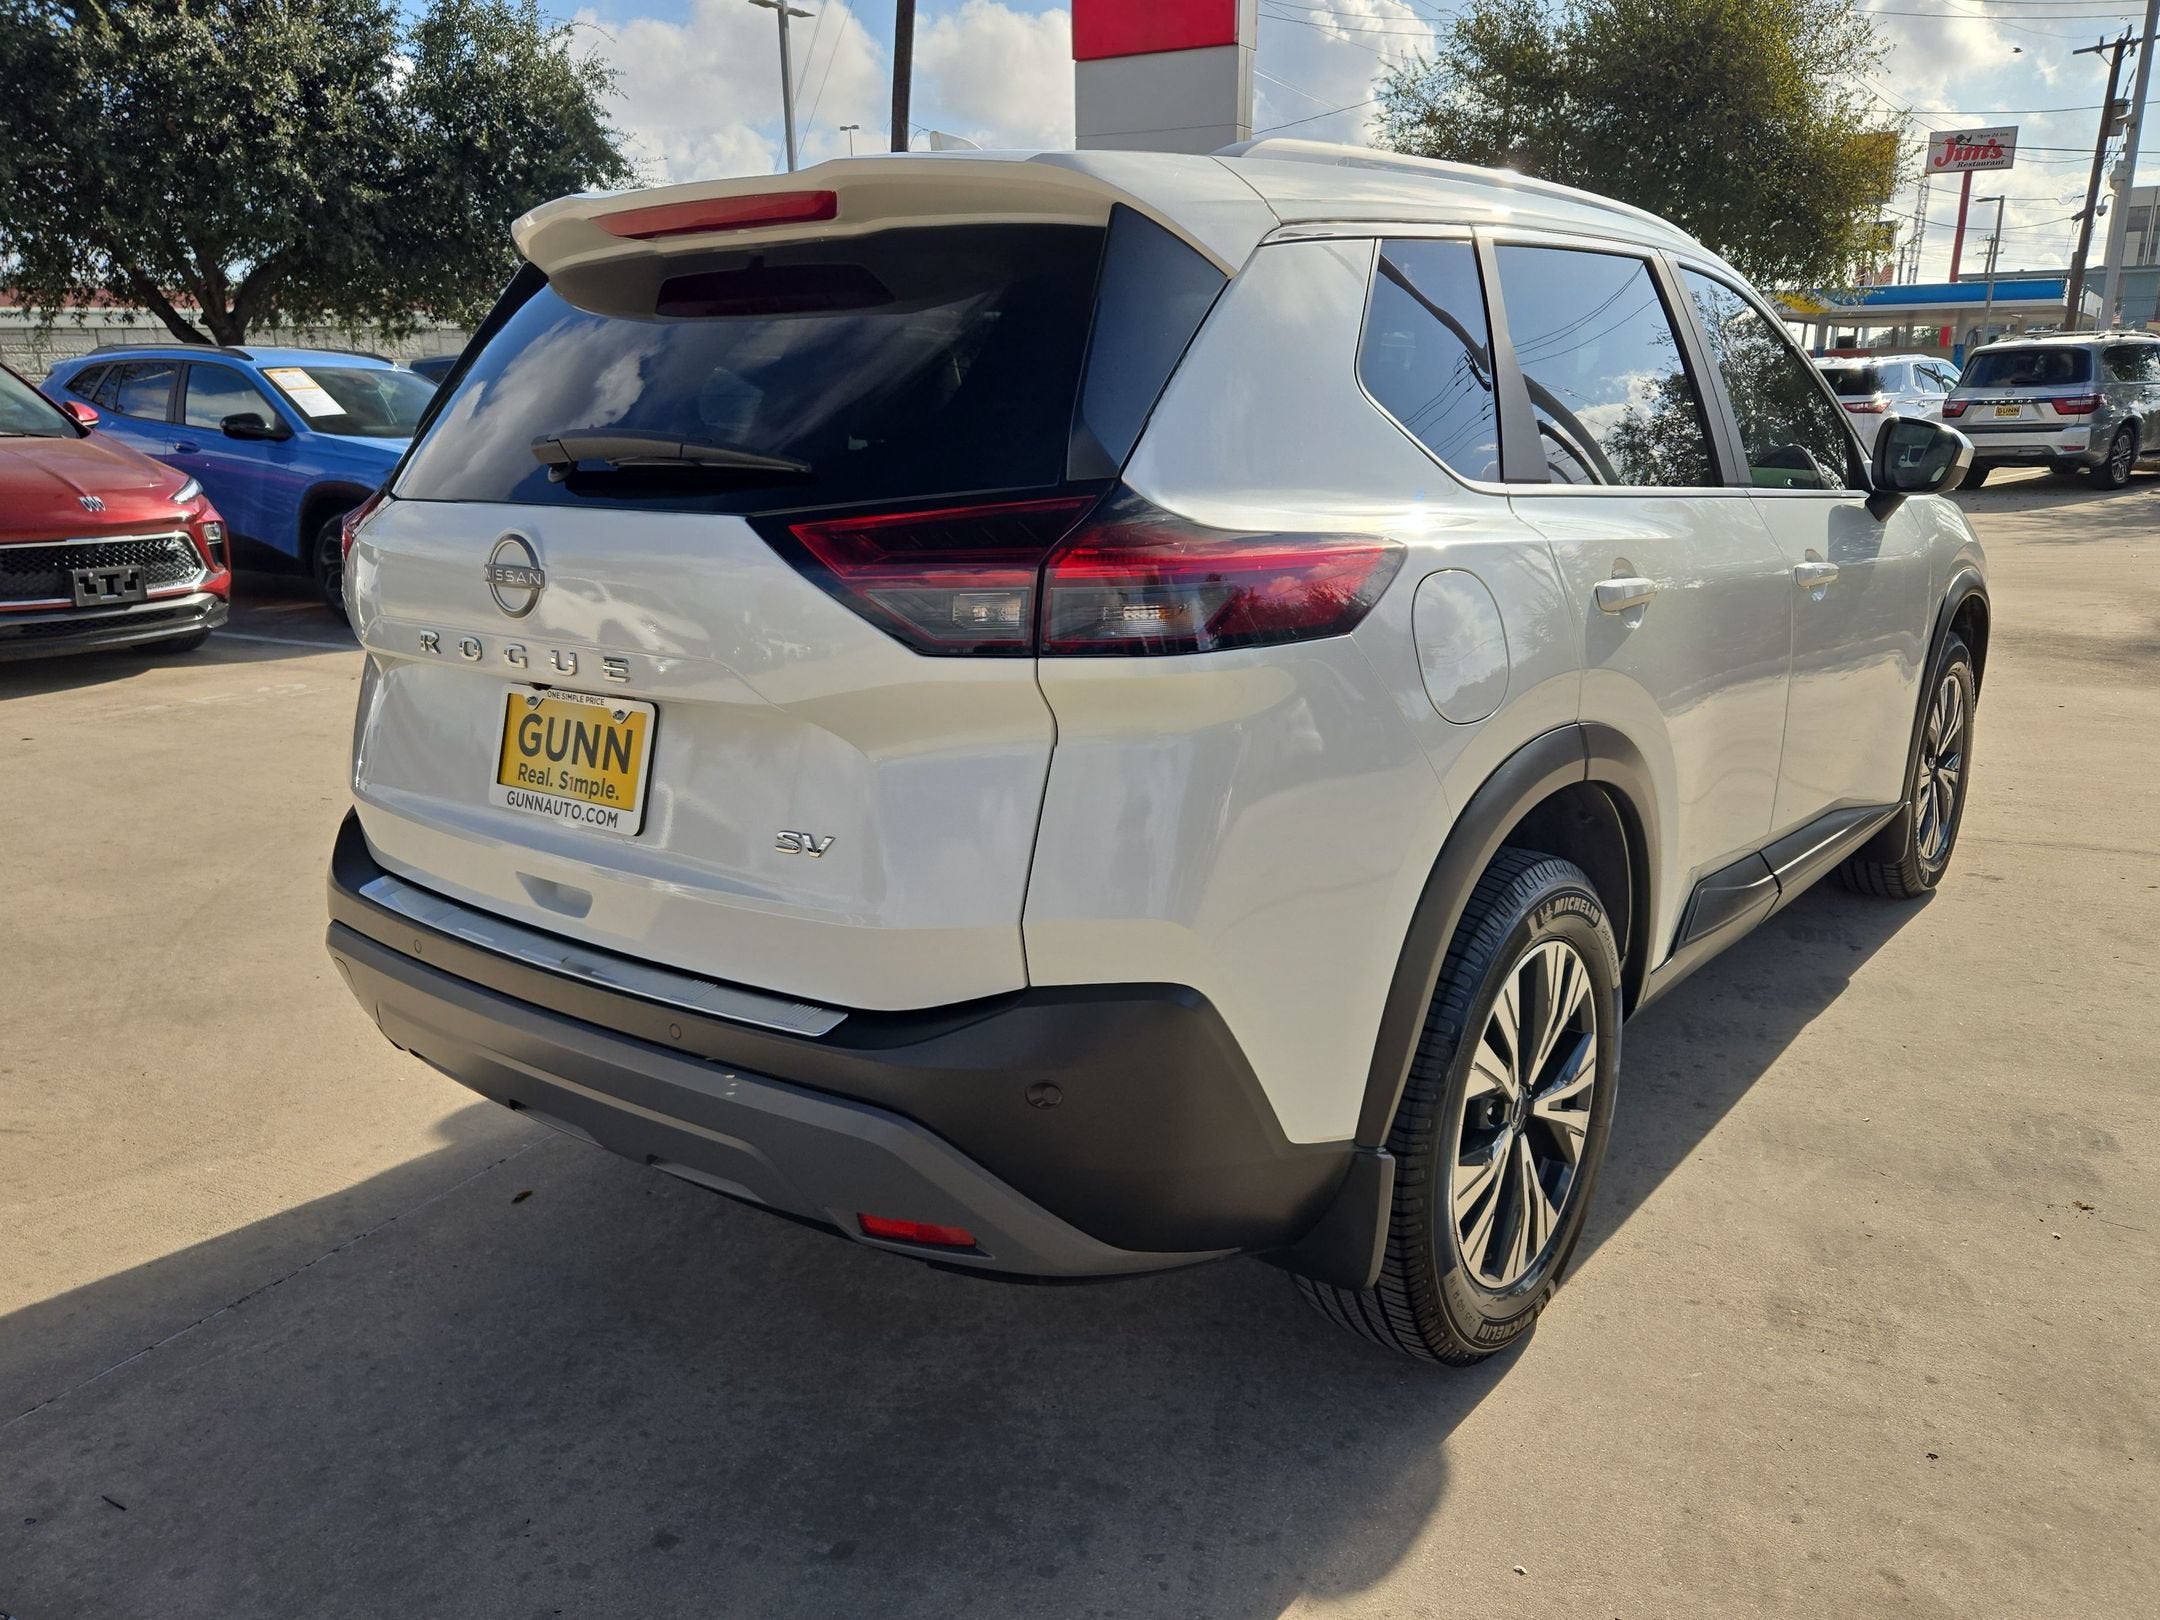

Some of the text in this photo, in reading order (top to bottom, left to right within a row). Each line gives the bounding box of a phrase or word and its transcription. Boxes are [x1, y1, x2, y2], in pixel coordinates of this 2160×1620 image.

[1934, 136, 2003, 168] Jim's
[1957, 160, 2005, 168] Restaurant
[483, 566, 542, 586] NISSAN
[420, 629, 631, 683] ROGUE
[547, 690, 605, 706] ONE SIMPLE PRICE
[518, 713, 633, 774] GUNN
[518, 763, 553, 787] Real.
[506, 790, 619, 828] GUNNAUTO.COM
[775, 830, 836, 858] SV
[1553, 896, 1601, 924] MICHELIN
[1477, 1307, 1535, 1341] MICHELIN
